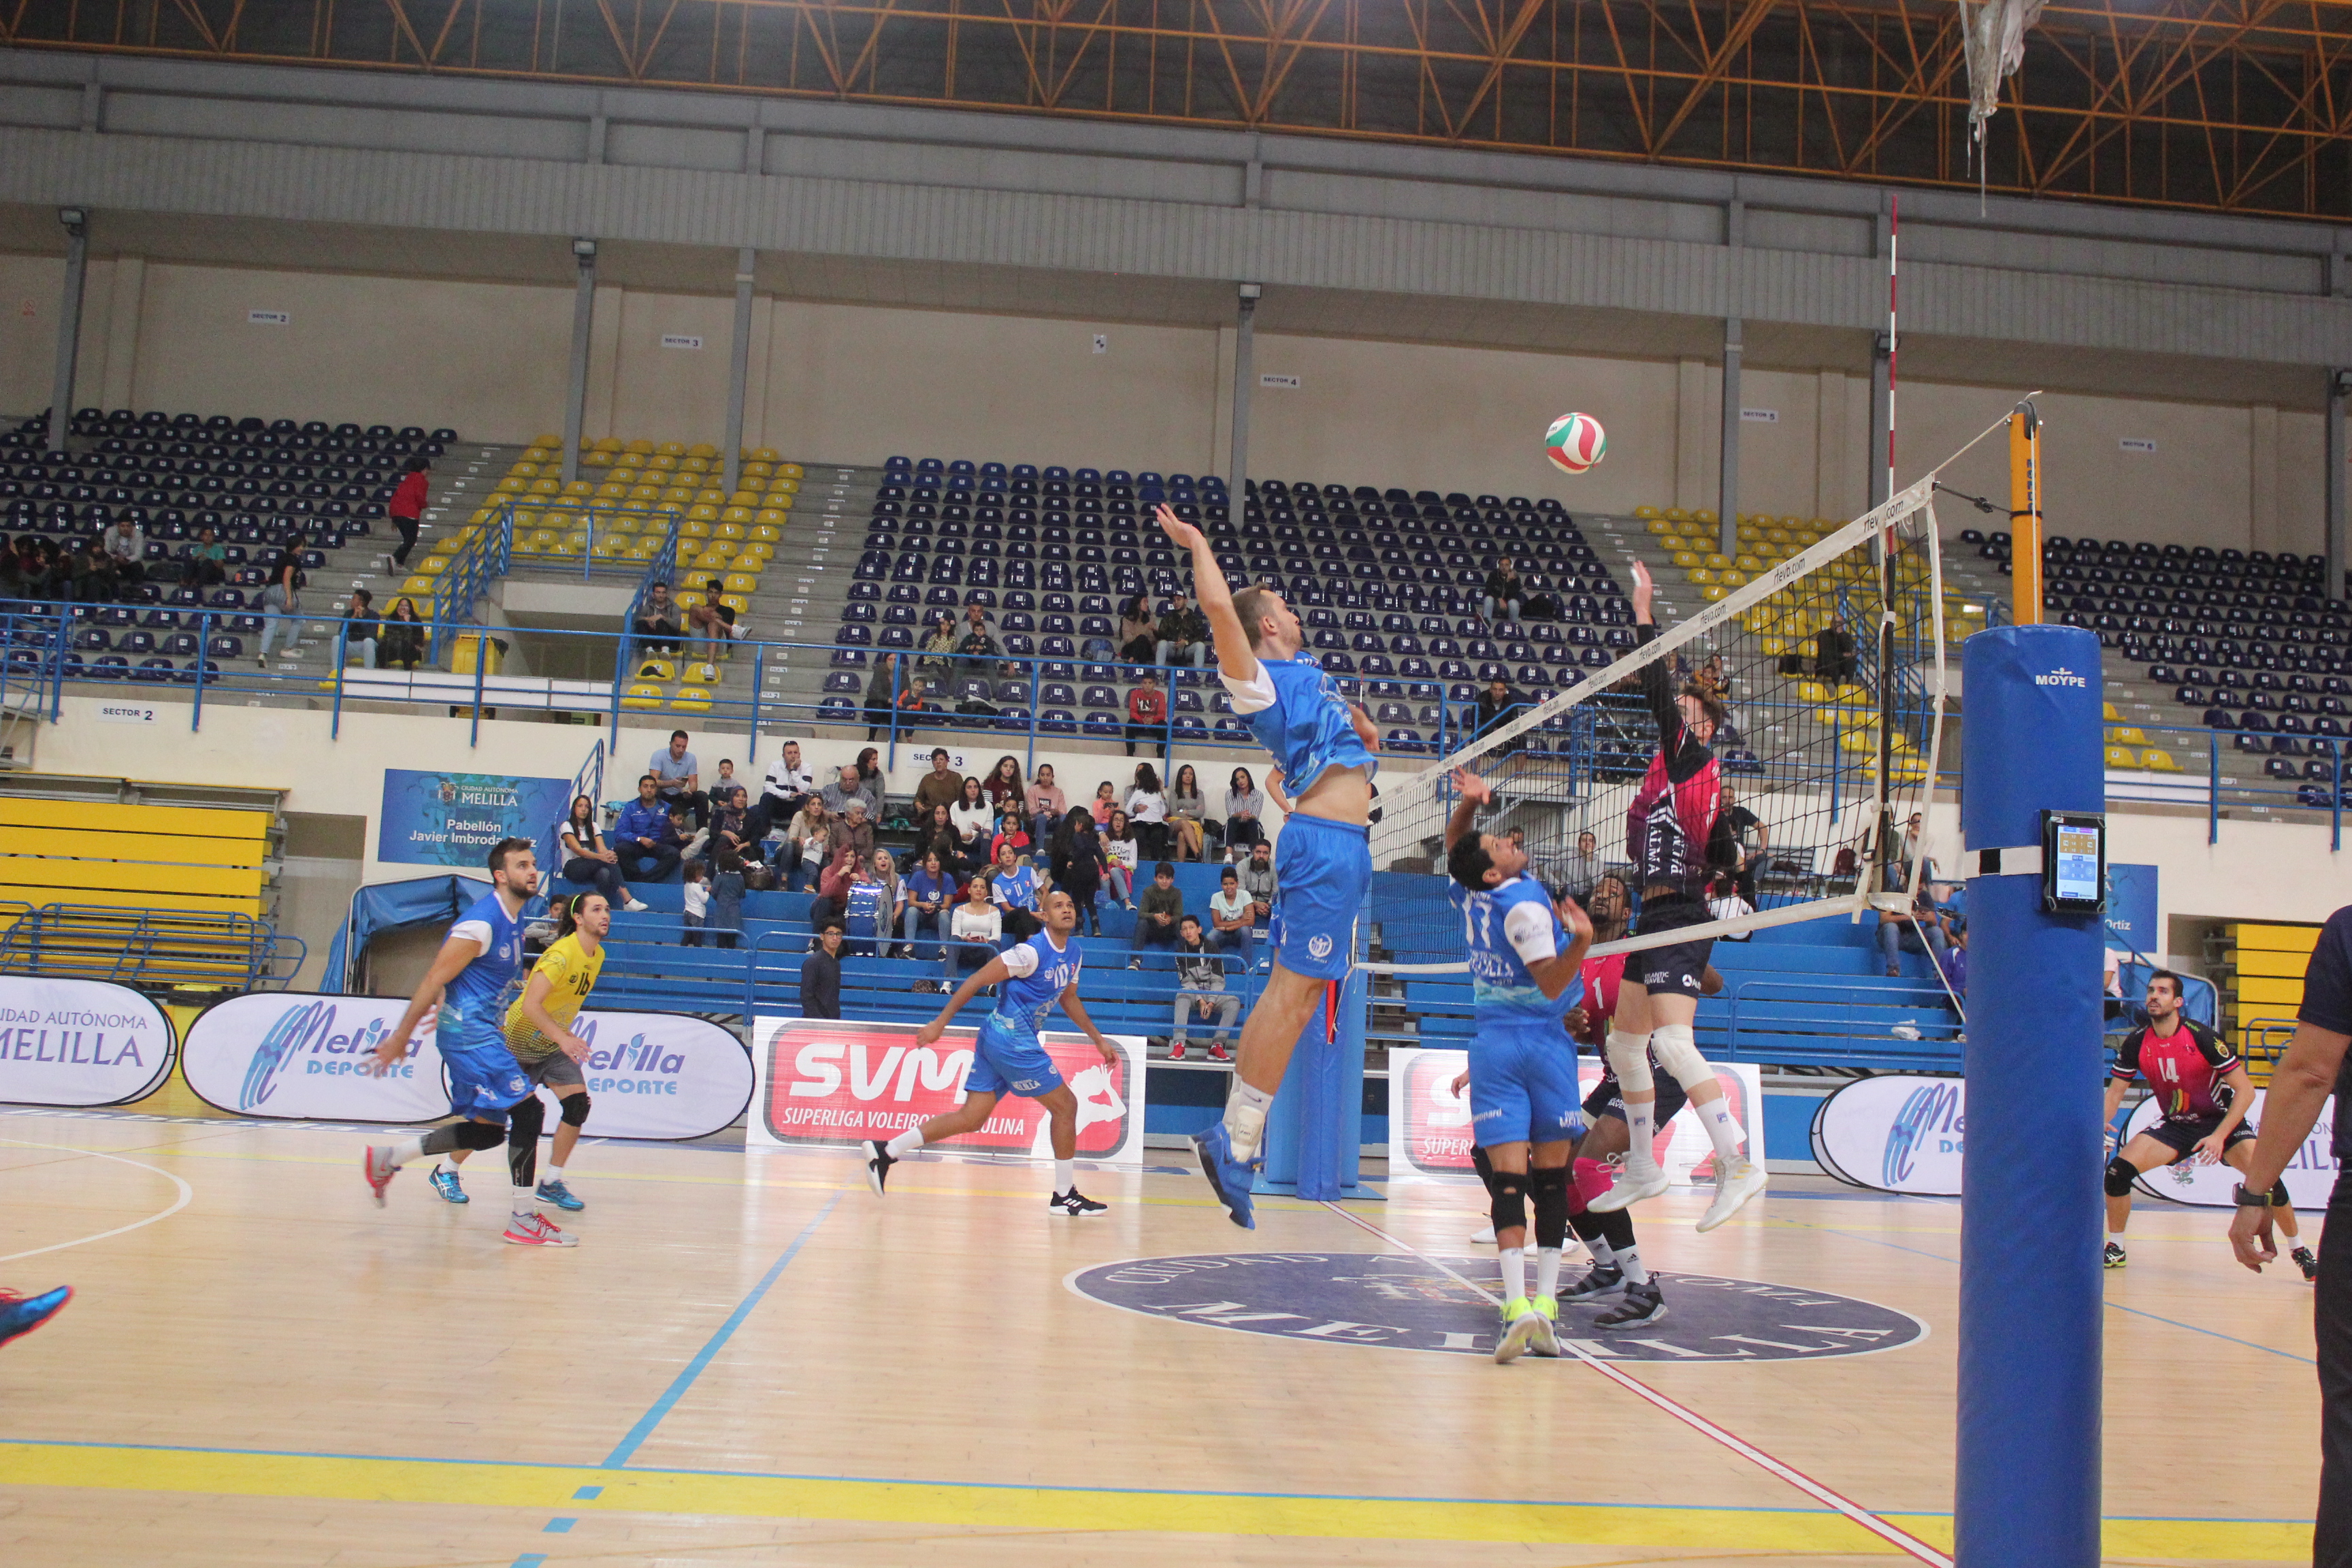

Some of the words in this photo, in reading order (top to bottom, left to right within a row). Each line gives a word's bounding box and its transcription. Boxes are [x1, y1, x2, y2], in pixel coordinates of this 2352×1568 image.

[693, 339, 698, 347] 3
[1863, 500, 1904, 534] rfev.com
[1773, 557, 1806, 585] rfevb.com
[2035, 674, 2086, 687] MOYPE
[103, 708, 140, 717] SECTOR
[144, 710, 154, 720] 2
[913, 753, 950, 762] SEC
[954, 756, 963, 766] 3
[461, 792, 518, 807] MELILLA
[447, 819, 501, 832] Pabellón
[410, 830, 448, 843] Javier
[452, 833, 502, 845] Imbroda
[1014, 883, 1024, 897] 11
[1463, 893, 1492, 949] 17
[2104, 919, 2132, 931] Ortíz
[574, 972, 589, 996] 16
[1055, 963, 1069, 990] 10
[1592, 977, 1603, 1009] 1
[45, 1010, 147, 1029] AUTÓNOMA
[788, 1043, 975, 1105] SVM
[2157, 1058, 2180, 1083] 14
[587, 1078, 677, 1095] EPORTE
[783, 1107, 864, 1127] SUPERLIGA
[868, 1111, 936, 1130] VOLEIBO
[974, 1117, 1025, 1136] ULINA
[1422, 1137, 1476, 1157] SUPER
[1104, 1254, 1329, 1285] CIUDAD
